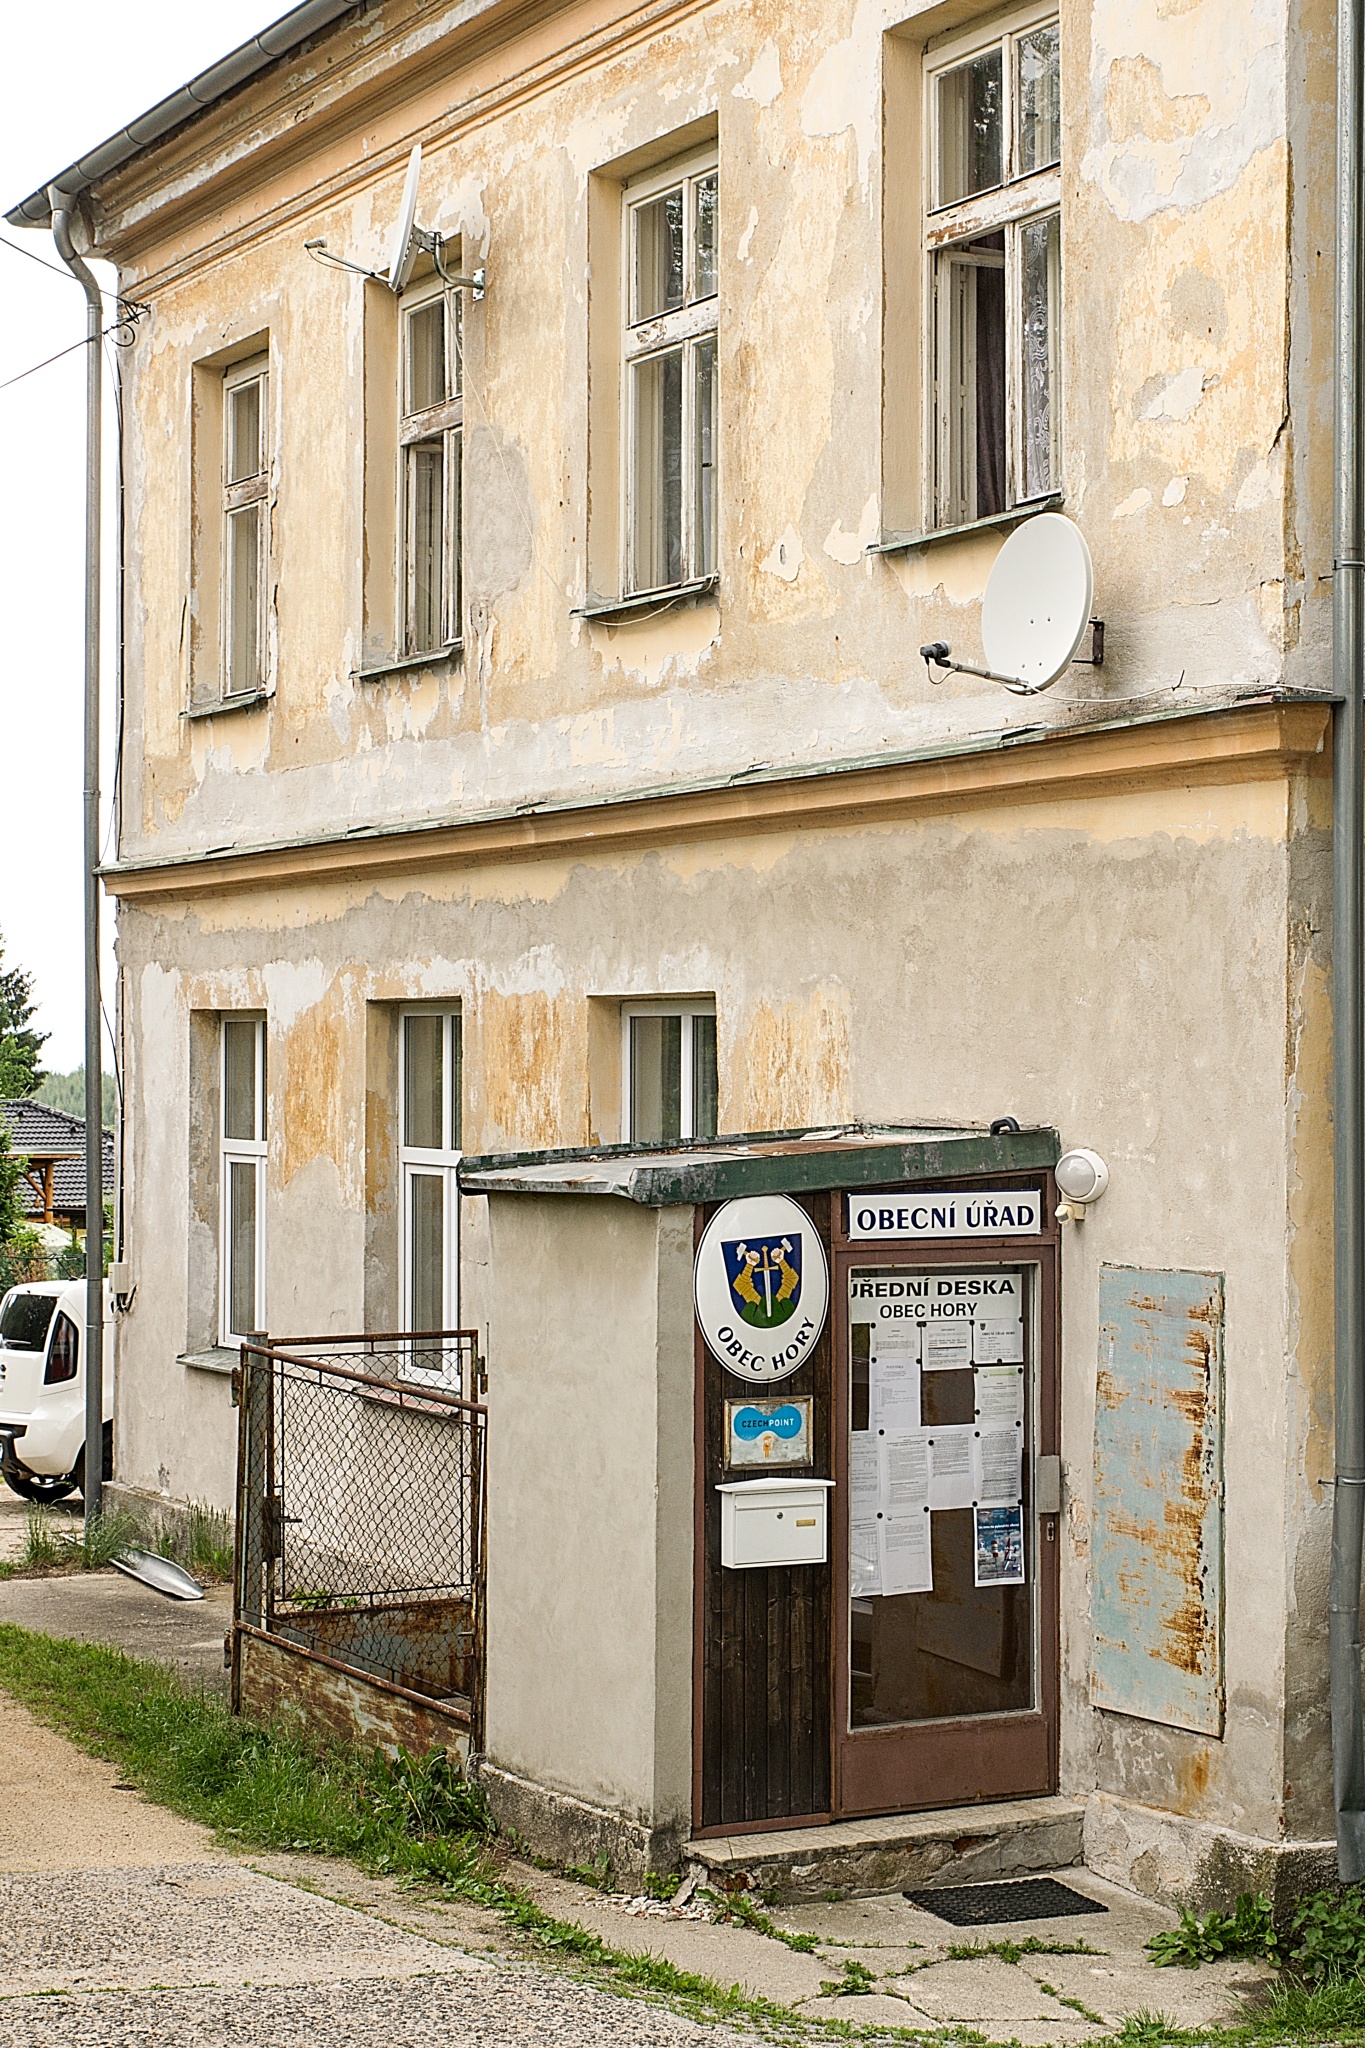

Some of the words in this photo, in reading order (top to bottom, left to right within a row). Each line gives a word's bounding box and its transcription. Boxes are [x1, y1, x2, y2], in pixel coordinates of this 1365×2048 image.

[857, 1201, 956, 1231] OBECNÍ
[966, 1200, 1034, 1228] ÚŘAD
[937, 1279, 1015, 1296] DESKA
[879, 1304, 926, 1318] OBEC
[930, 1302, 978, 1317] HORY
[717, 1326, 765, 1371] OBEC
[771, 1316, 815, 1371] HORY
